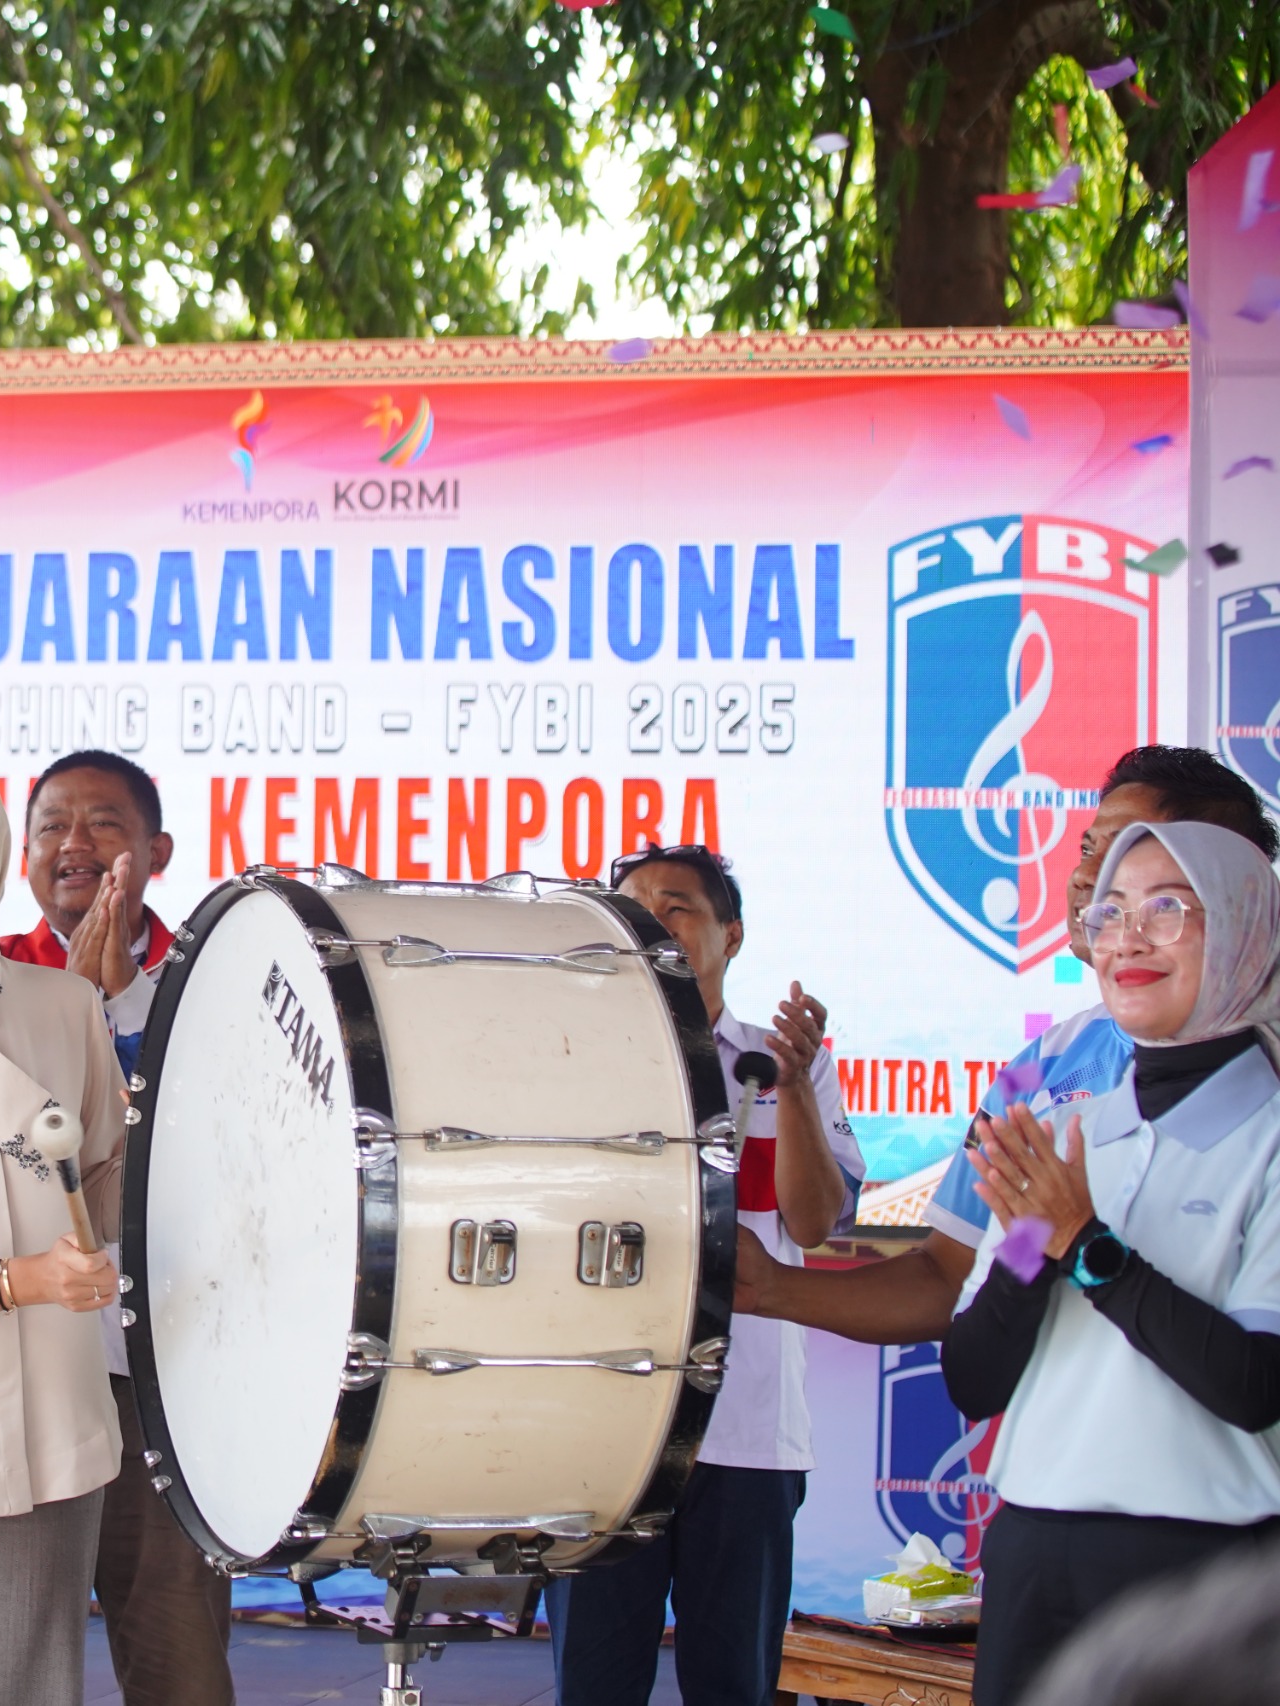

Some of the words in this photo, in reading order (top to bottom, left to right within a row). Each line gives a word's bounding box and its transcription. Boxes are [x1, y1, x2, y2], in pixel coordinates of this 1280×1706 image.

[182, 501, 320, 523] KEMENPORA
[334, 479, 460, 512] KORMI
[369, 543, 856, 662] NASIONAL
[179, 683, 348, 753] BAND
[380, 710, 412, 734] -
[445, 683, 594, 753] FYBI
[627, 682, 797, 754] 2025
[208, 776, 723, 881] KEMENPORA
[964, 787, 1017, 809] YOUTH
[1022, 789, 1066, 809] BAND
[274, 978, 336, 1107] TAMA
[837, 1058, 952, 1114] MITRA
